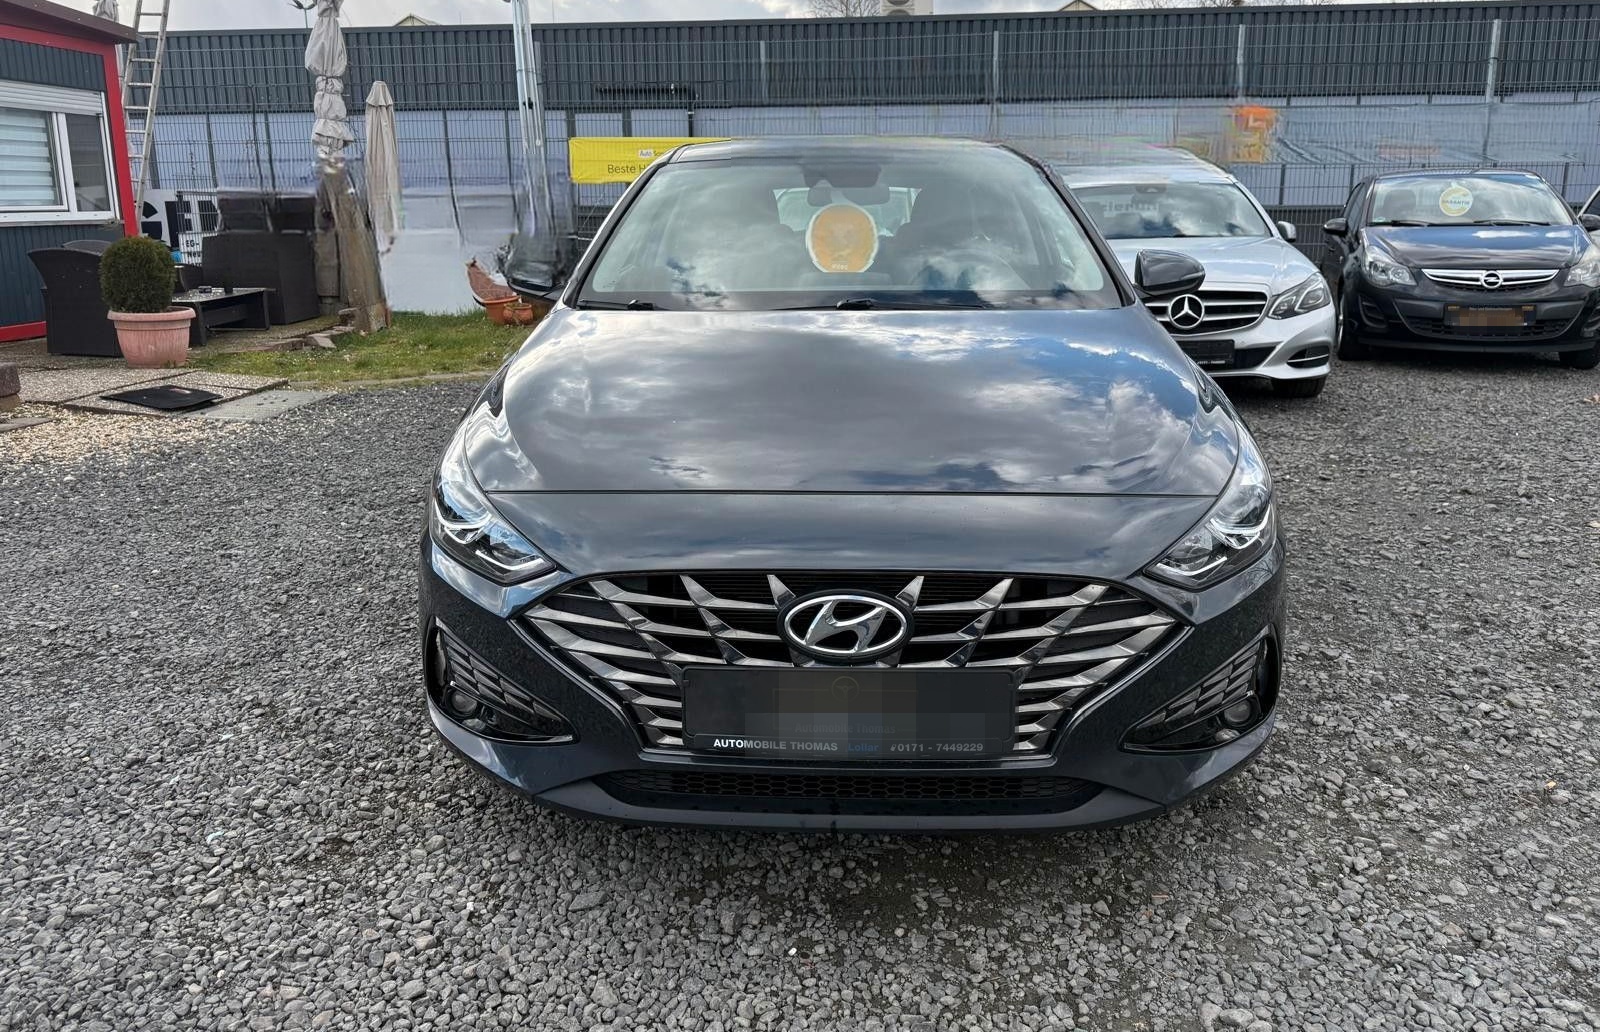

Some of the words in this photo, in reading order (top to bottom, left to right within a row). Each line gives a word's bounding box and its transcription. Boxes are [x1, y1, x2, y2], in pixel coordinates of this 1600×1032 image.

[607, 164, 636, 174] Beste
[713, 739, 787, 750] AUTOMOBILE
[790, 742, 839, 751] THOMAS
[897, 744, 924, 752] 0171
[936, 743, 984, 752] 7449229
